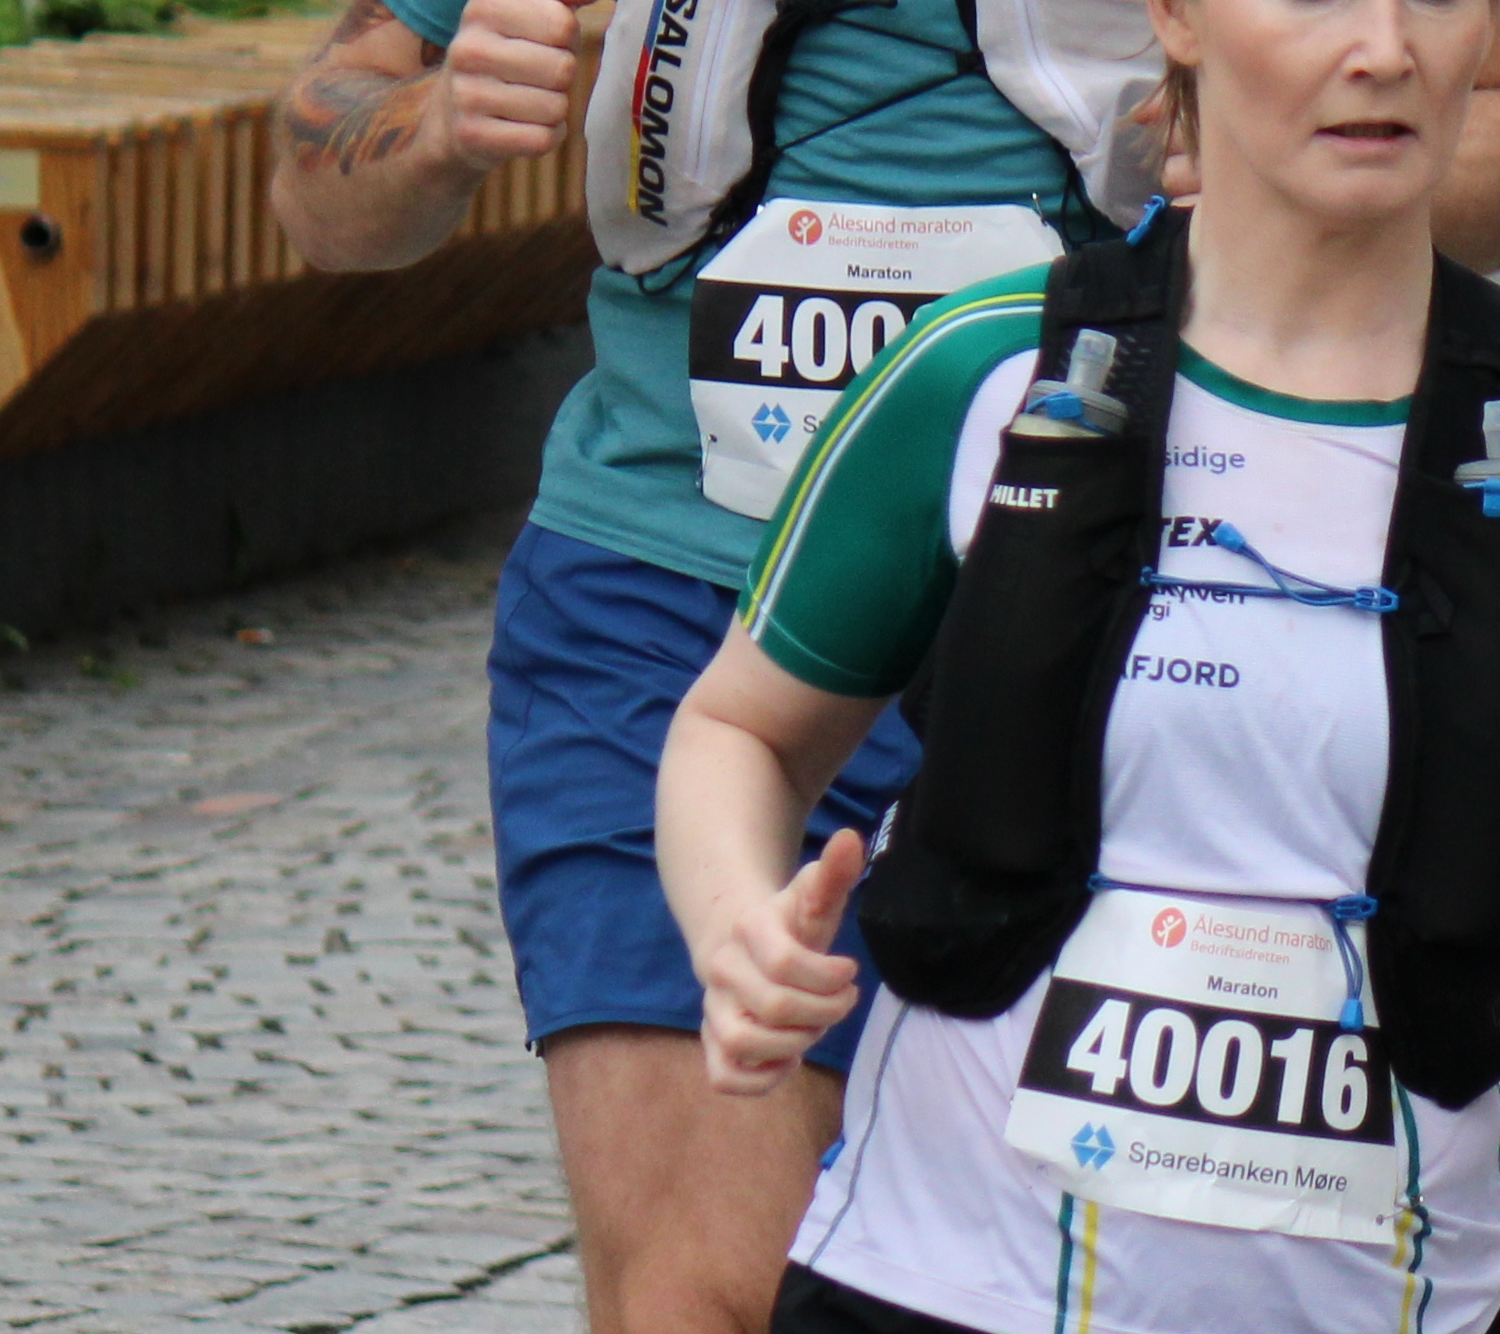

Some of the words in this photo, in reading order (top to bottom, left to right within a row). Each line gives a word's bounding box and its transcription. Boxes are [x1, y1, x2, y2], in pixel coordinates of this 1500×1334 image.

[827, 212, 896, 234] Ålesund
[900, 218, 974, 234] maraton
[827, 235, 919, 250] Bedriftsidretten
[847, 264, 913, 281] Maraton
[733, 294, 936, 383] 400
[989, 483, 1059, 509] MILLET
[1193, 914, 1270, 944] Ålesund
[1273, 928, 1334, 953] maraton
[1189, 940, 1291, 965] Bedriftsidretten
[1206, 974, 1280, 1000] Maraton
[1066, 998, 1369, 1132] 40016
[1128, 1141, 1289, 1187] Sparebanken
[1294, 1167, 1348, 1192] Møre
